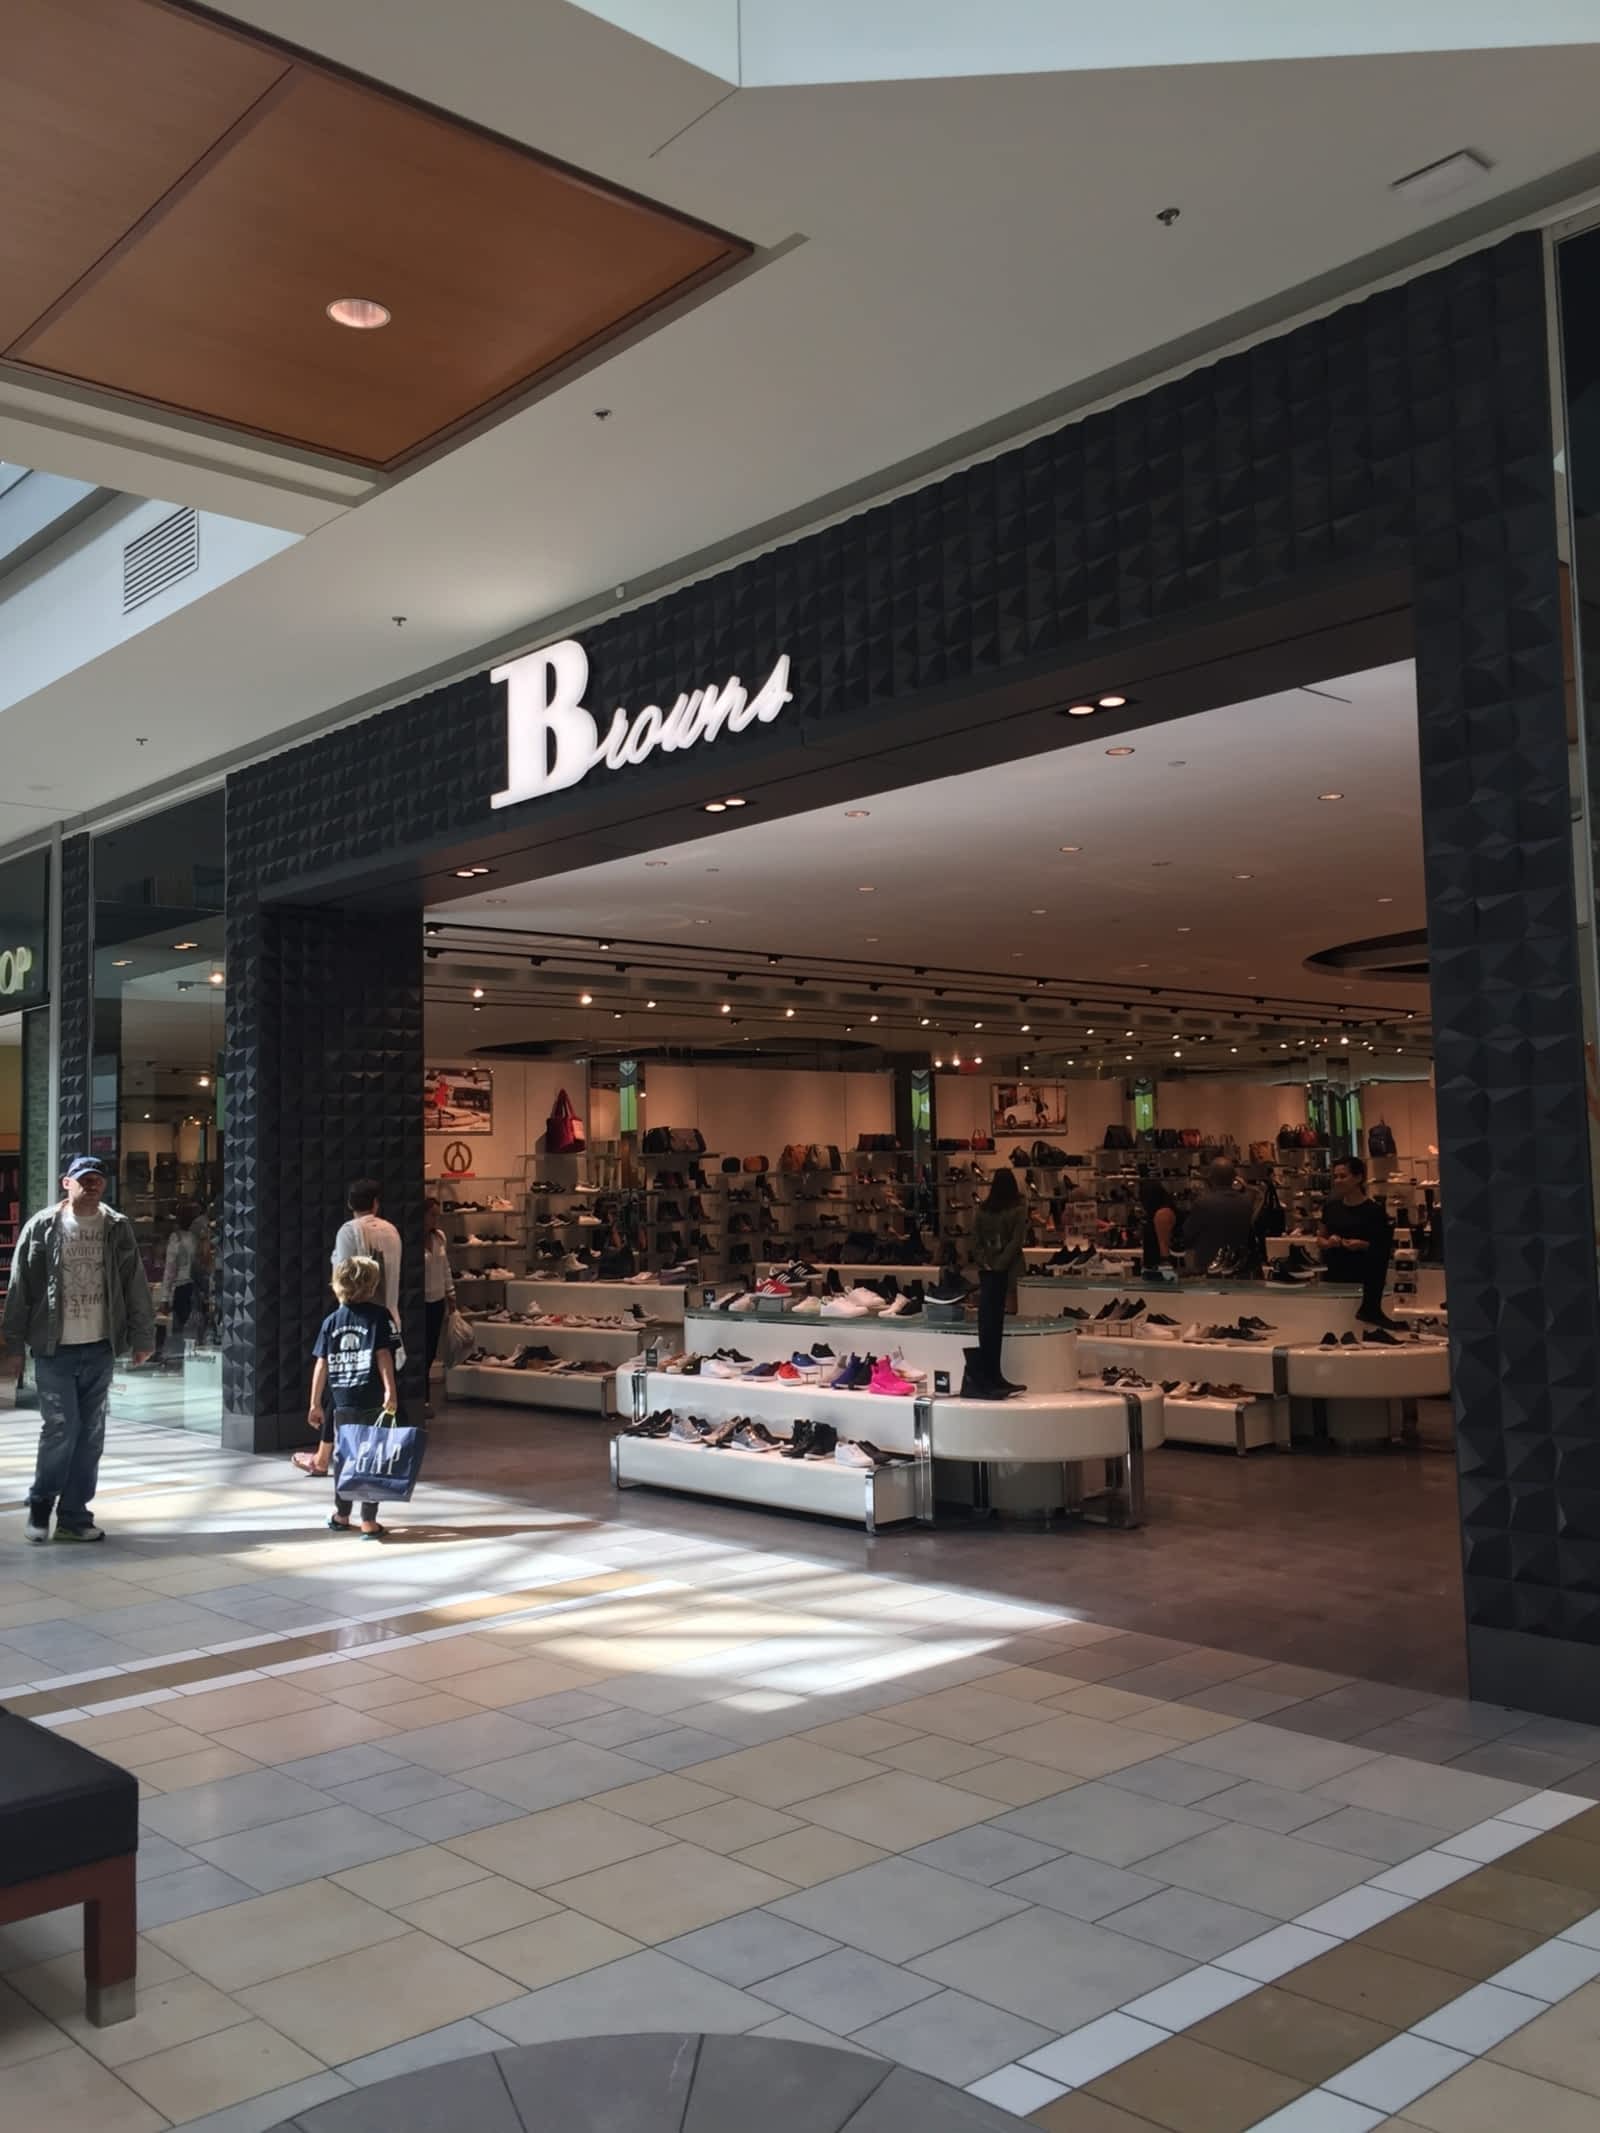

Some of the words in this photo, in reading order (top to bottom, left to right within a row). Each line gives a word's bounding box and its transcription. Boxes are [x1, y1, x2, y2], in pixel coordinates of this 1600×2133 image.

[491, 640, 793, 809] Browns
[0, 947, 32, 994] OP
[328, 1349, 372, 1364] COURSE
[355, 1440, 402, 1475] GAP
